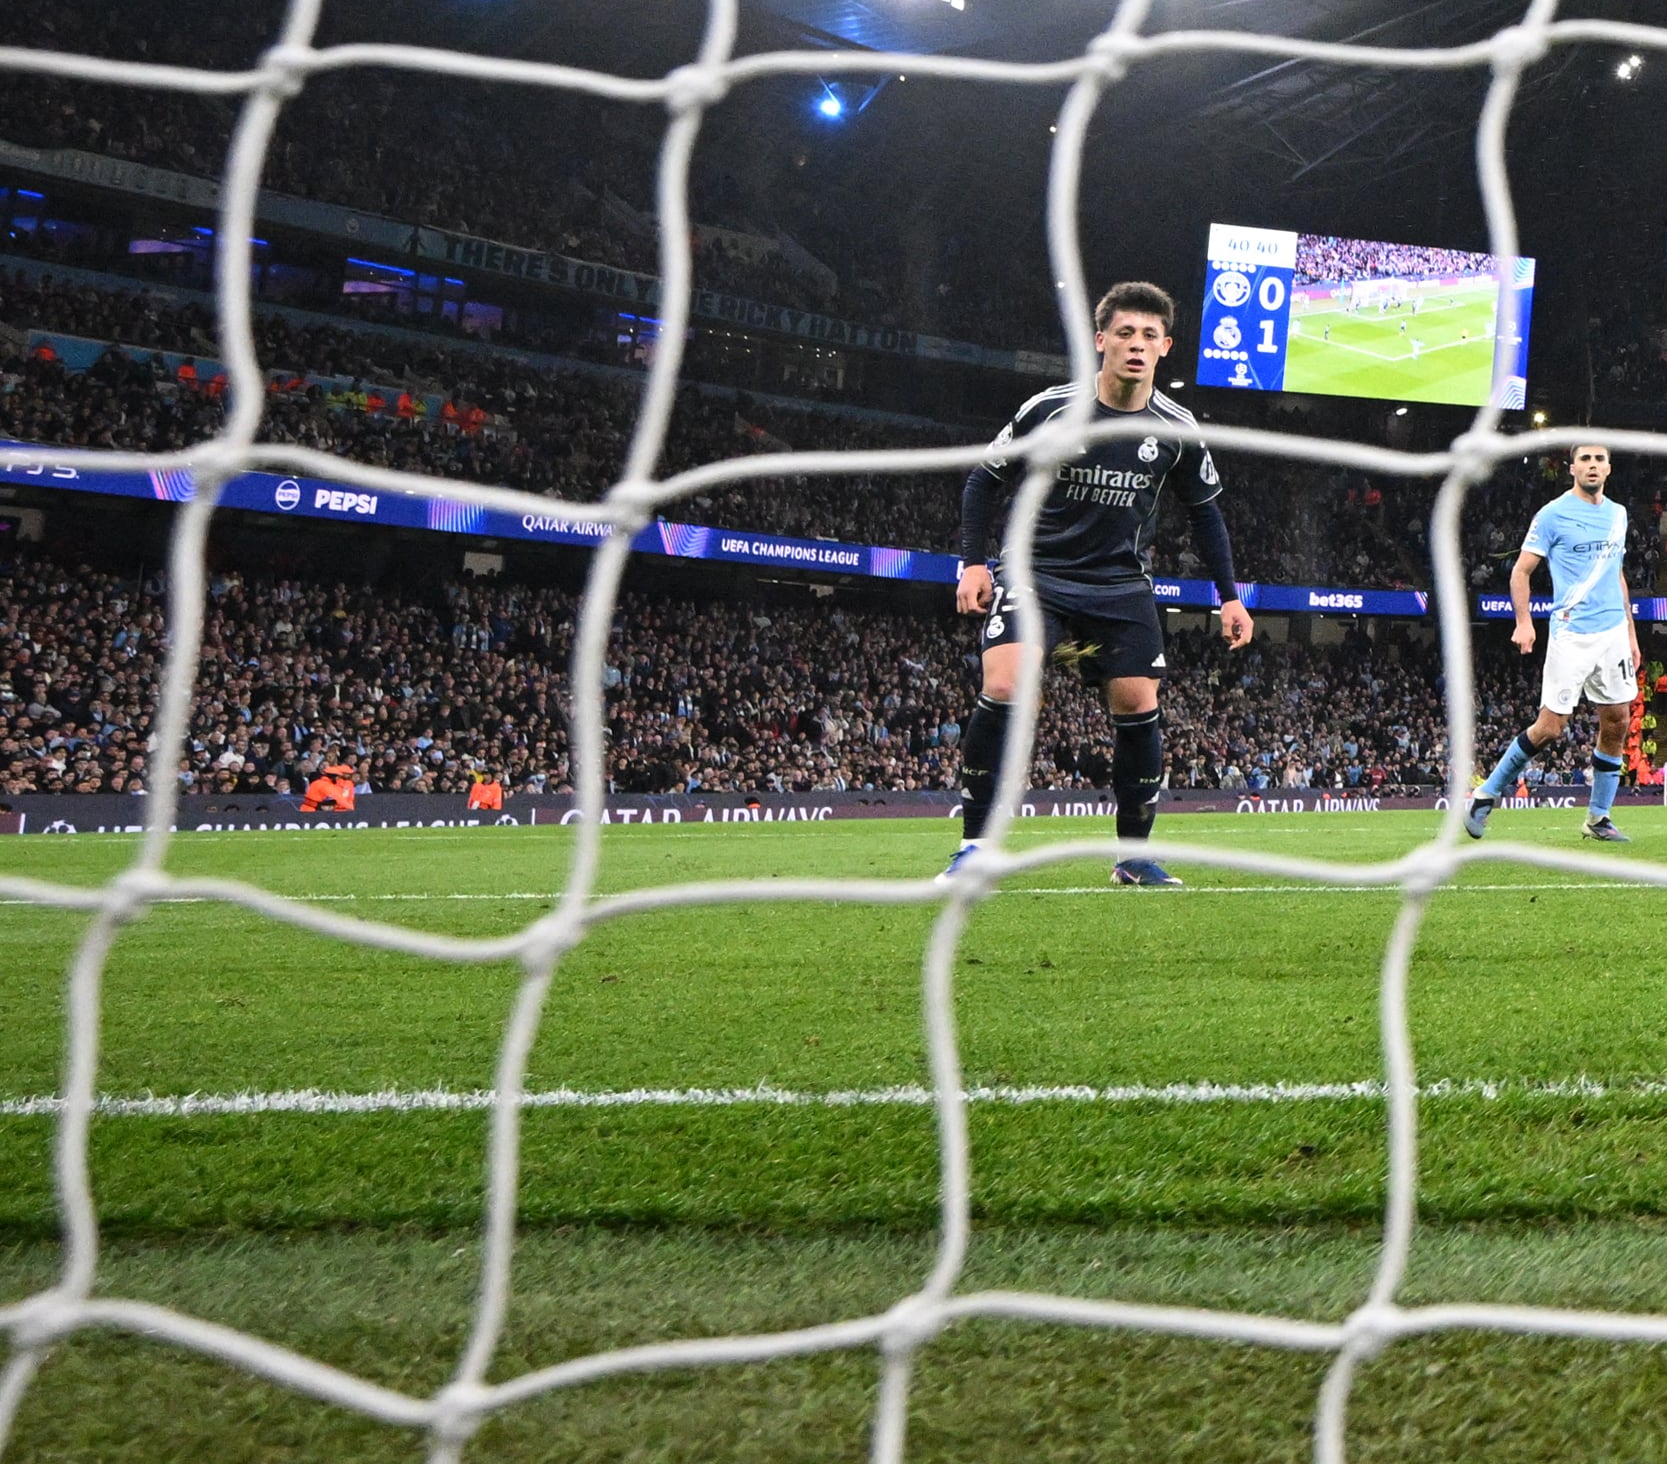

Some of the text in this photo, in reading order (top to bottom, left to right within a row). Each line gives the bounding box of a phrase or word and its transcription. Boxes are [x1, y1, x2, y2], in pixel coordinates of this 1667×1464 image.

[1259, 276, 1285, 311] 0
[1257, 319, 1278, 353] 1
[1057, 464, 1153, 488] Emirates
[315, 489, 378, 515] PEPSI
[1066, 485, 1136, 507] FLY BETTER
[522, 515, 569, 534] QATAR
[722, 538, 860, 566] UEFA CHAMPIONS LEAGUE
[1309, 592, 1363, 609] bet365
[1482, 600, 1512, 612] UEFA
